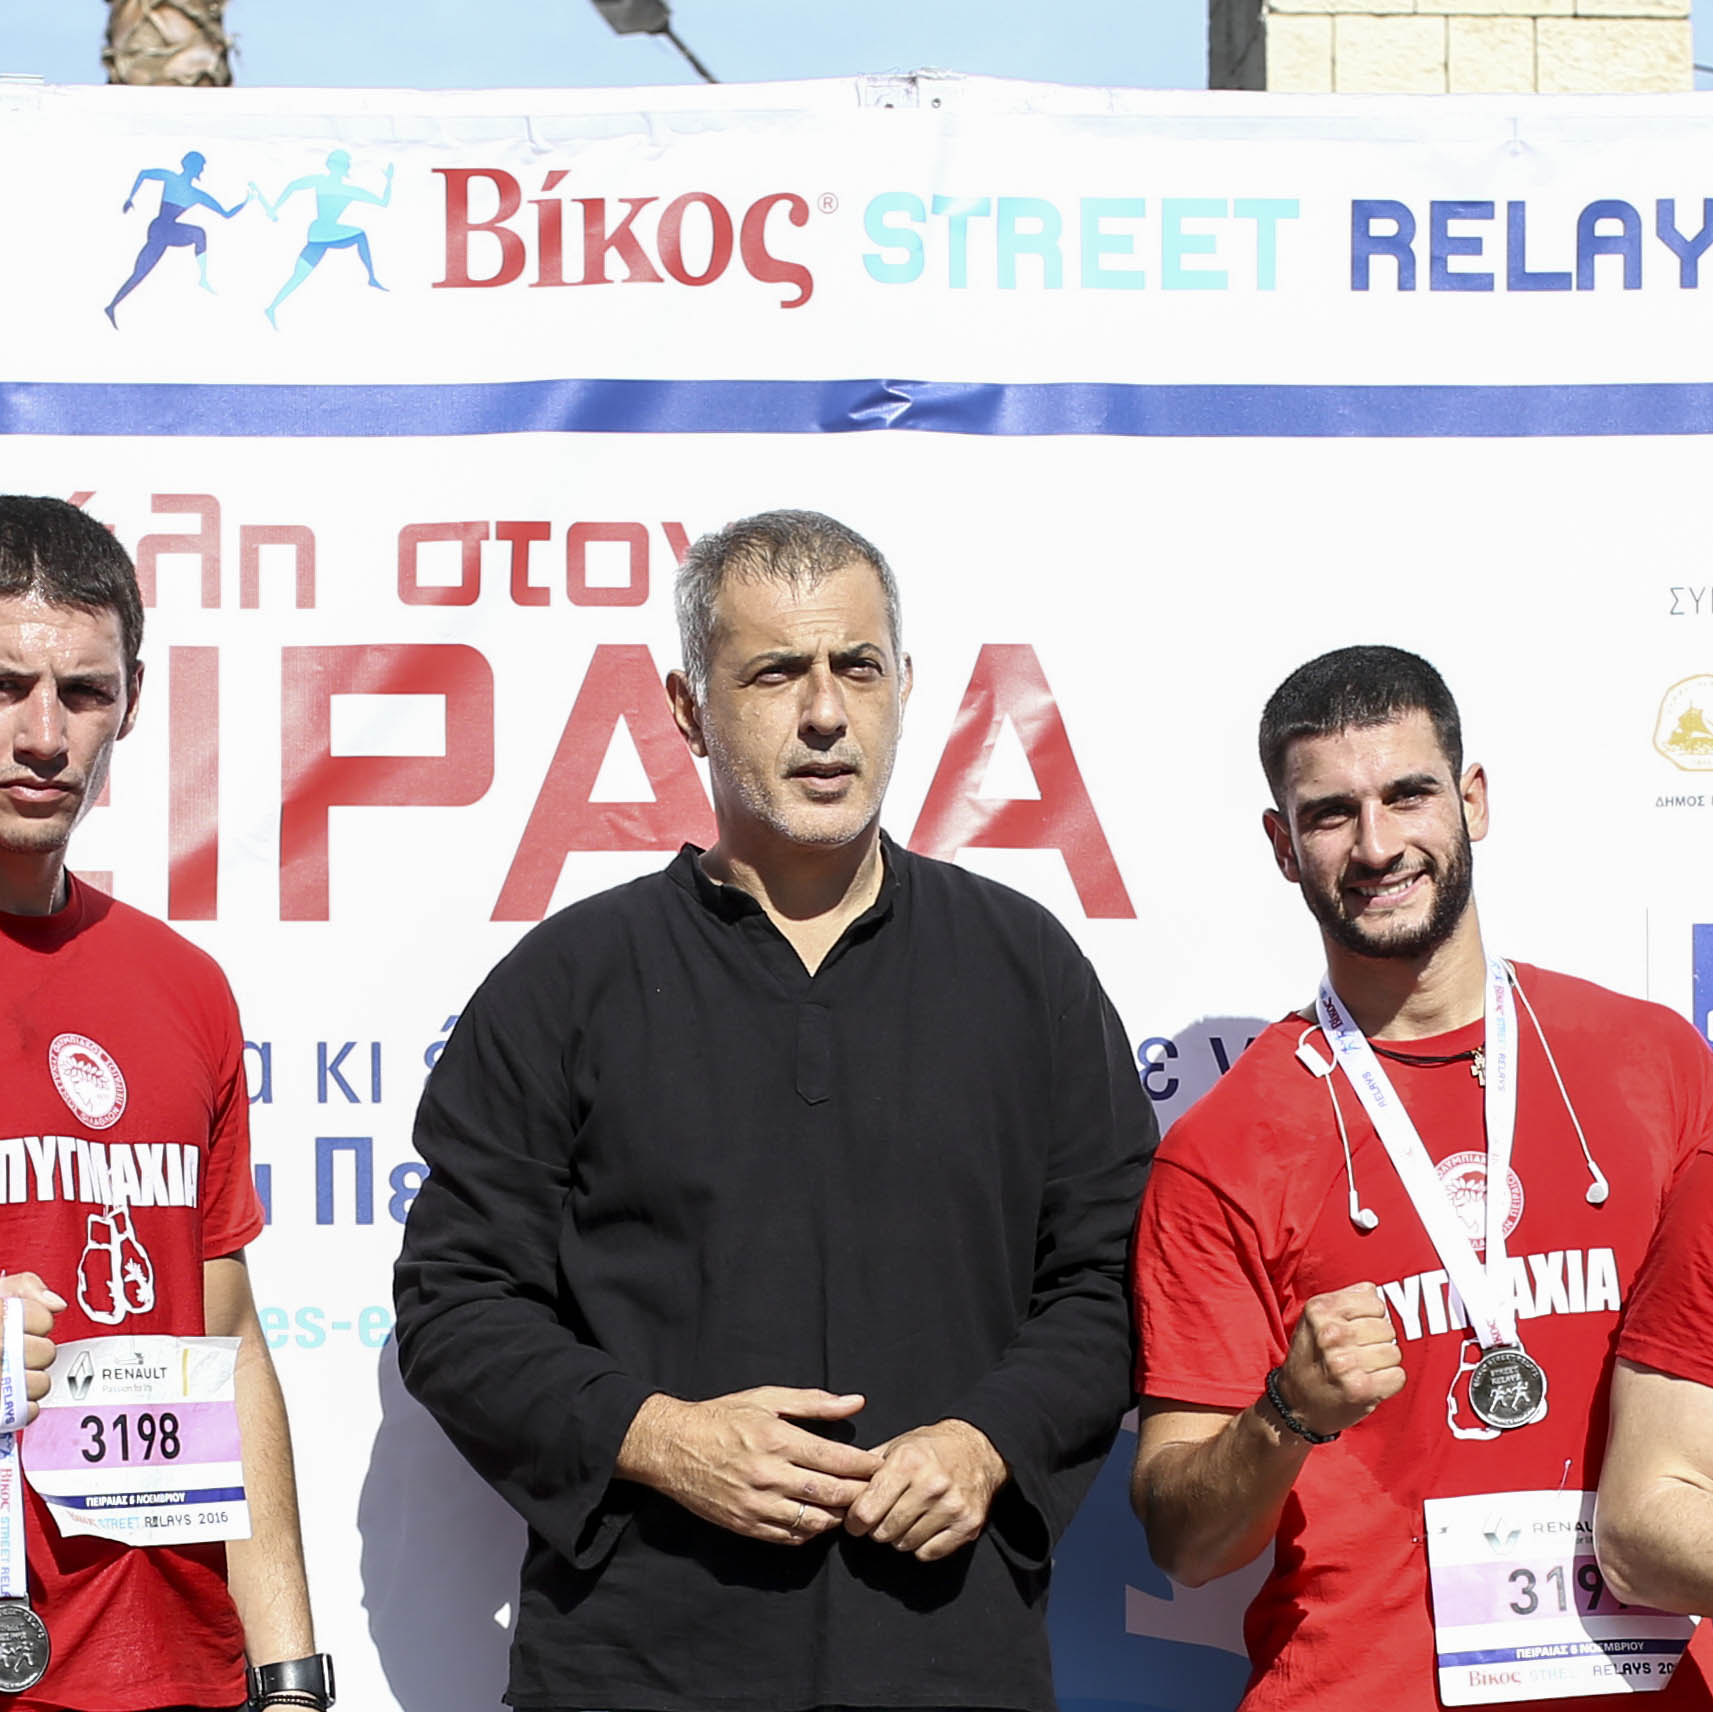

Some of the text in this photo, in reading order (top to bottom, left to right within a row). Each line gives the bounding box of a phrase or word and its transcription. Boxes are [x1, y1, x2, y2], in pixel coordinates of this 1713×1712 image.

[430, 166, 816, 310] Βίκος
[861, 190, 1300, 292] STREET
[1655, 795, 1705, 808] ΔΗΜΟΣ
[101, 1367, 168, 1381] RENAULT
[79, 1411, 182, 1464] 3198
[199, 1511, 229, 1524] 2016
[1515, 1646, 1569, 1659] ΠΕΙΡΑΙΑΣ
[1581, 1640, 1645, 1656] ΝΟΕΜΒΡΙΟΥ
[1592, 1662, 1652, 1677] RELAYS
